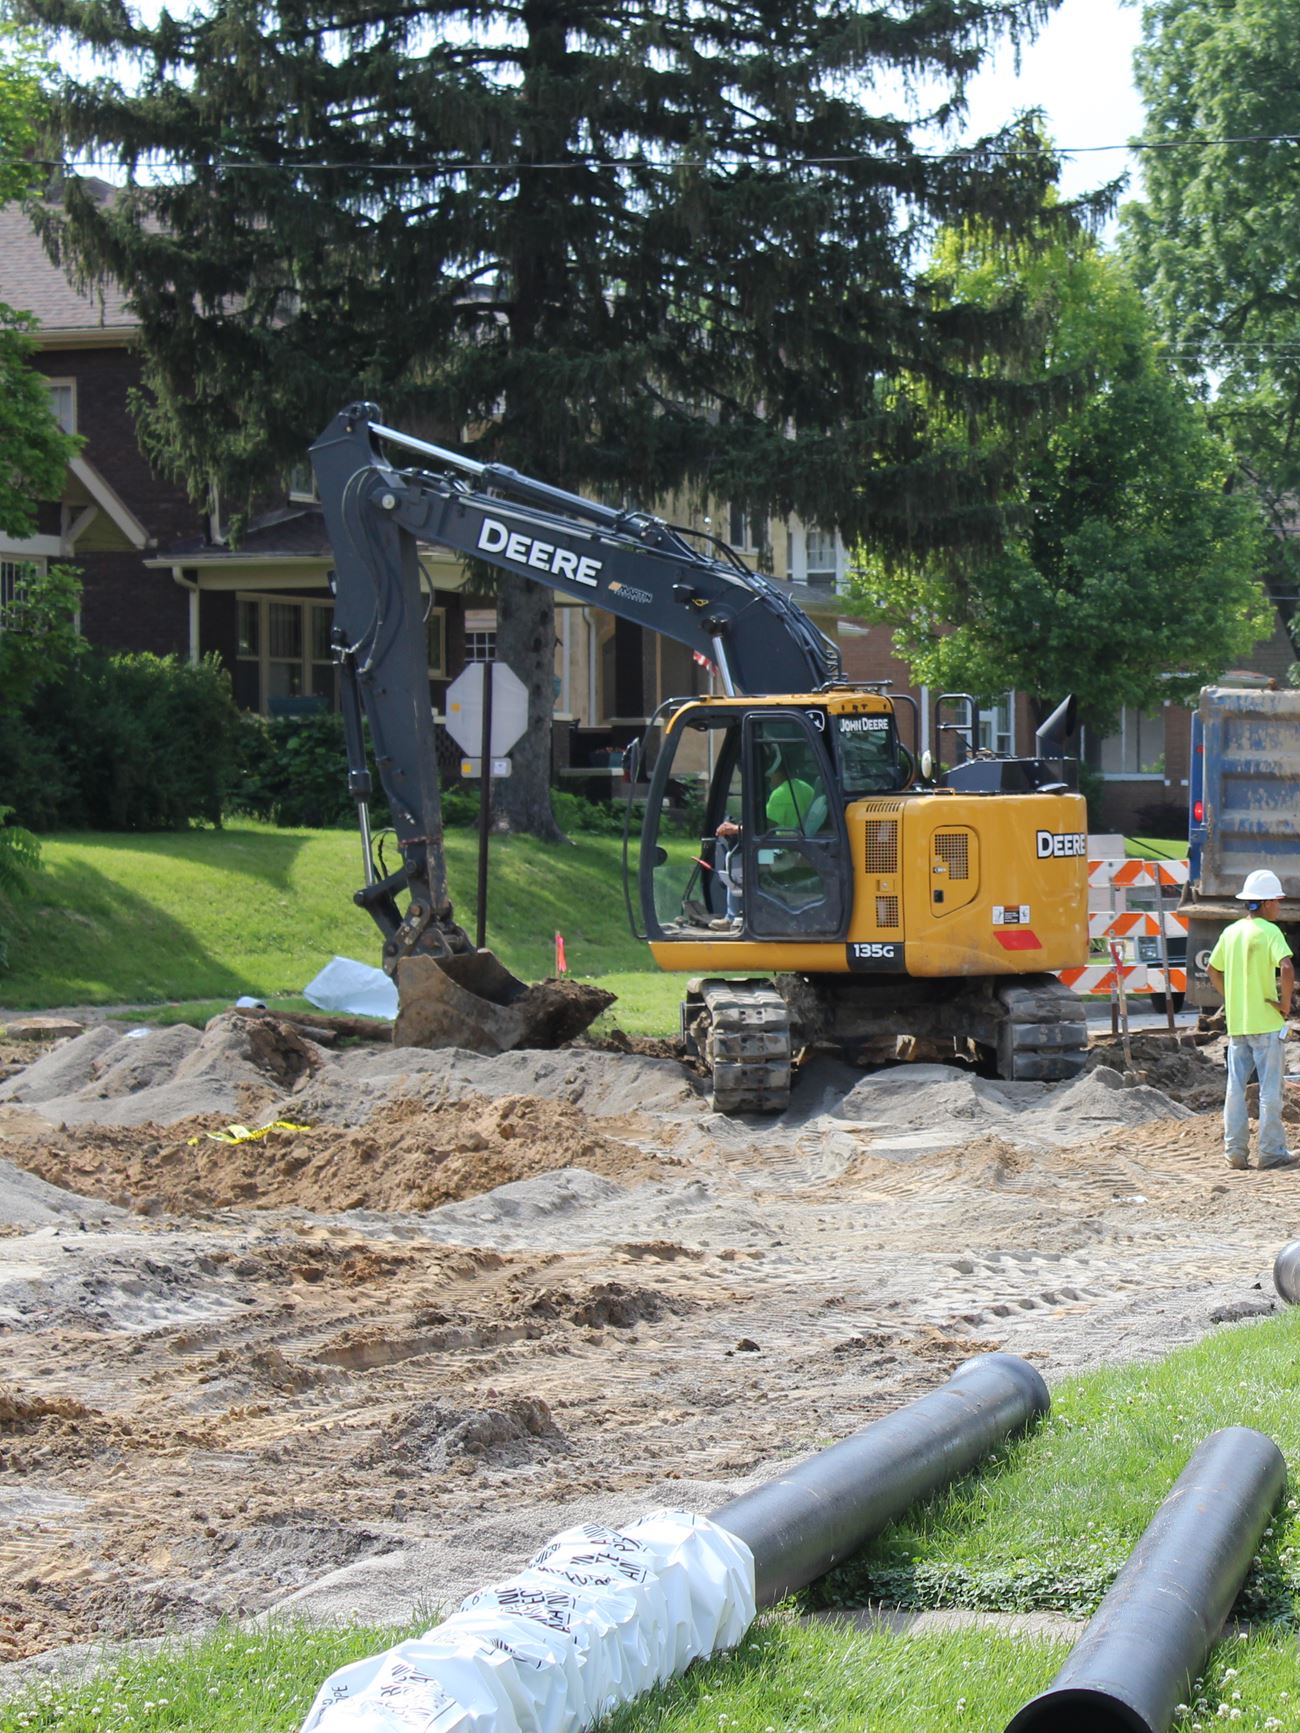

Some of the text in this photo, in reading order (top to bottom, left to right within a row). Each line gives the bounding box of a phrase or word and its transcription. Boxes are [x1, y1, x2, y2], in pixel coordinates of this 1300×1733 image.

[478, 518, 602, 587] DEERE
[840, 717, 889, 732] JOHN DEERE
[1036, 830, 1086, 858] DEERE
[853, 943, 895, 958] 135G
